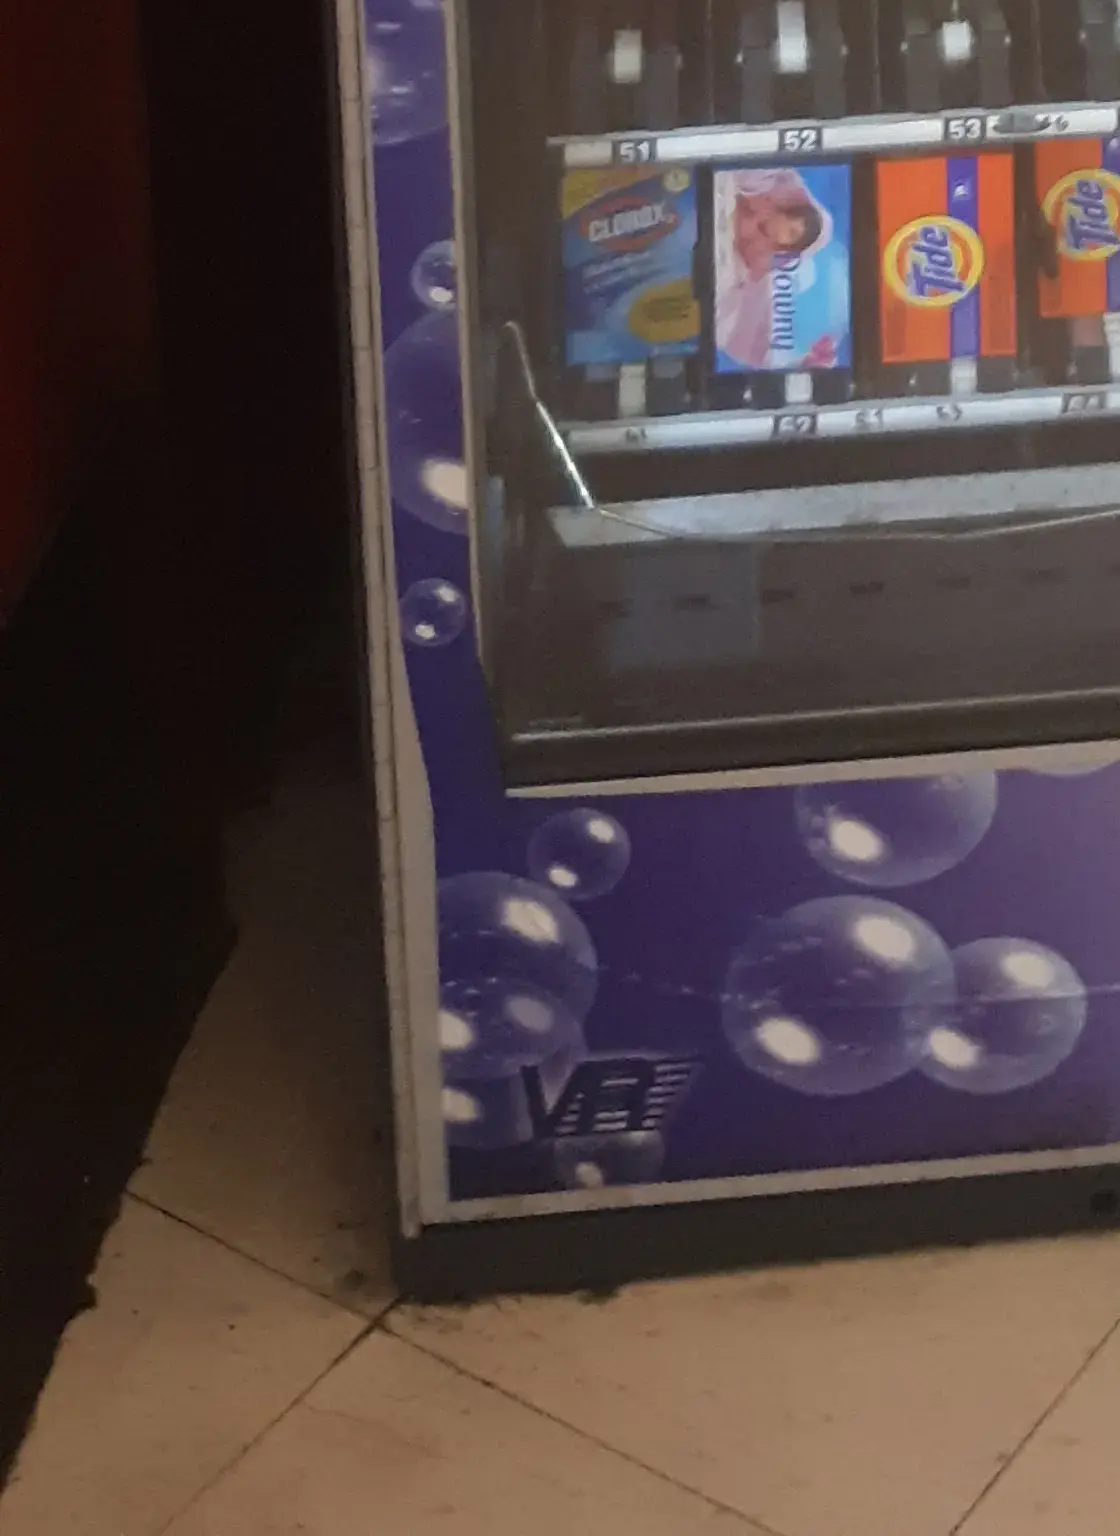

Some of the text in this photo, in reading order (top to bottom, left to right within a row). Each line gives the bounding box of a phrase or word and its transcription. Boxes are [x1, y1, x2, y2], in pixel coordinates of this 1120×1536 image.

[619, 142, 652, 163] 51
[783, 129, 818, 150] 52
[948, 118, 982, 140] 53
[909, 225, 966, 297] Tide
